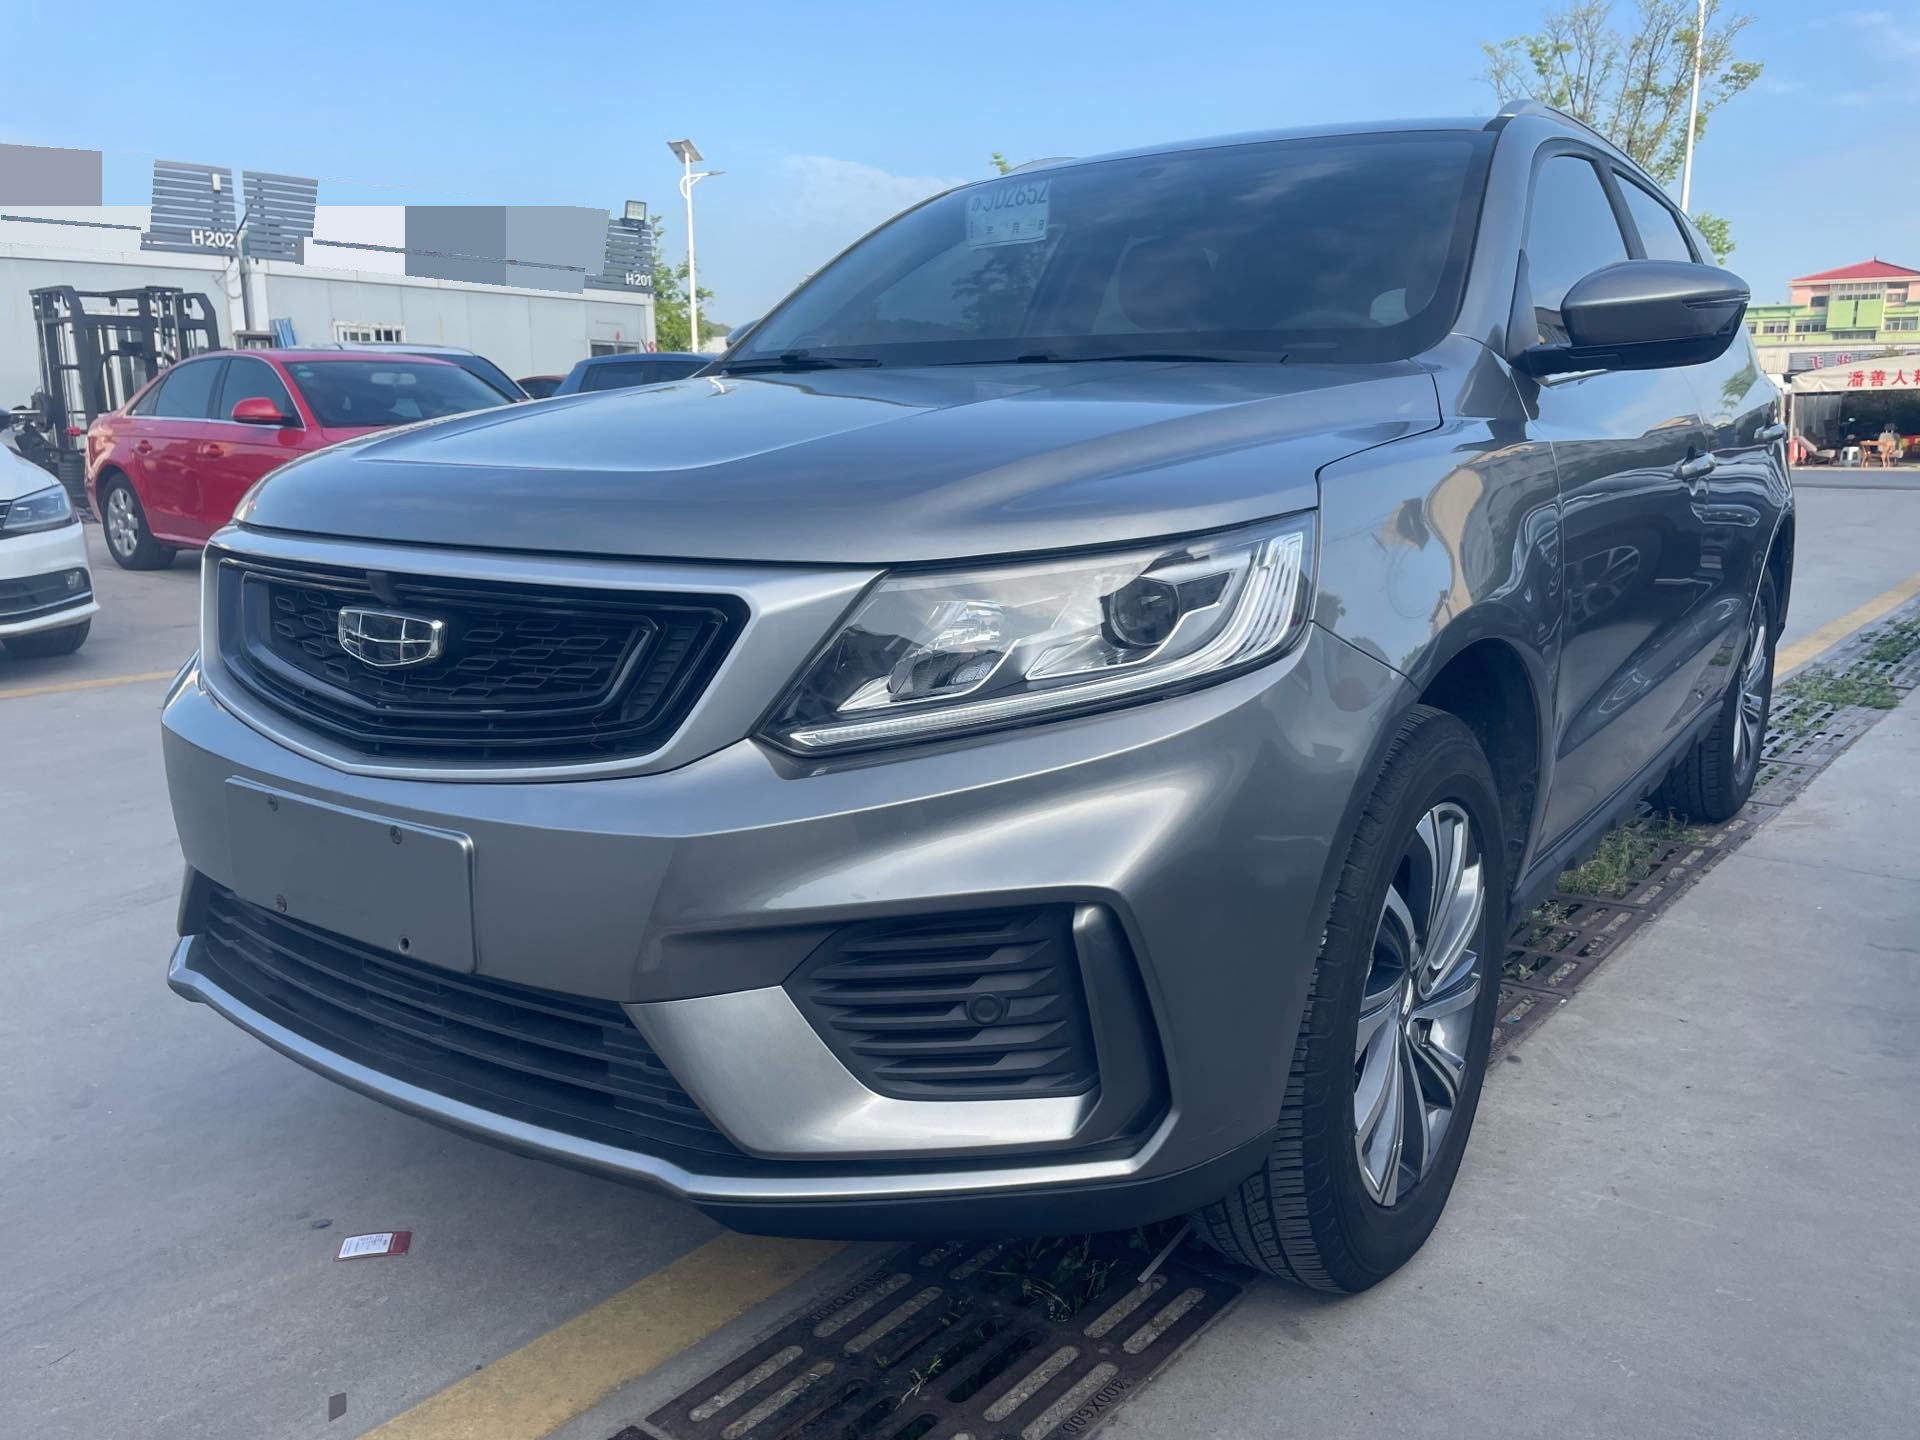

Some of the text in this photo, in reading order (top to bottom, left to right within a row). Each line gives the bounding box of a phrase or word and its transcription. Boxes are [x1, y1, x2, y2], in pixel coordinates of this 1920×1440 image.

[191, 229, 235, 249] H202
[625, 272, 651, 287] H201
[1062, 1377, 1127, 1433] 400X600
